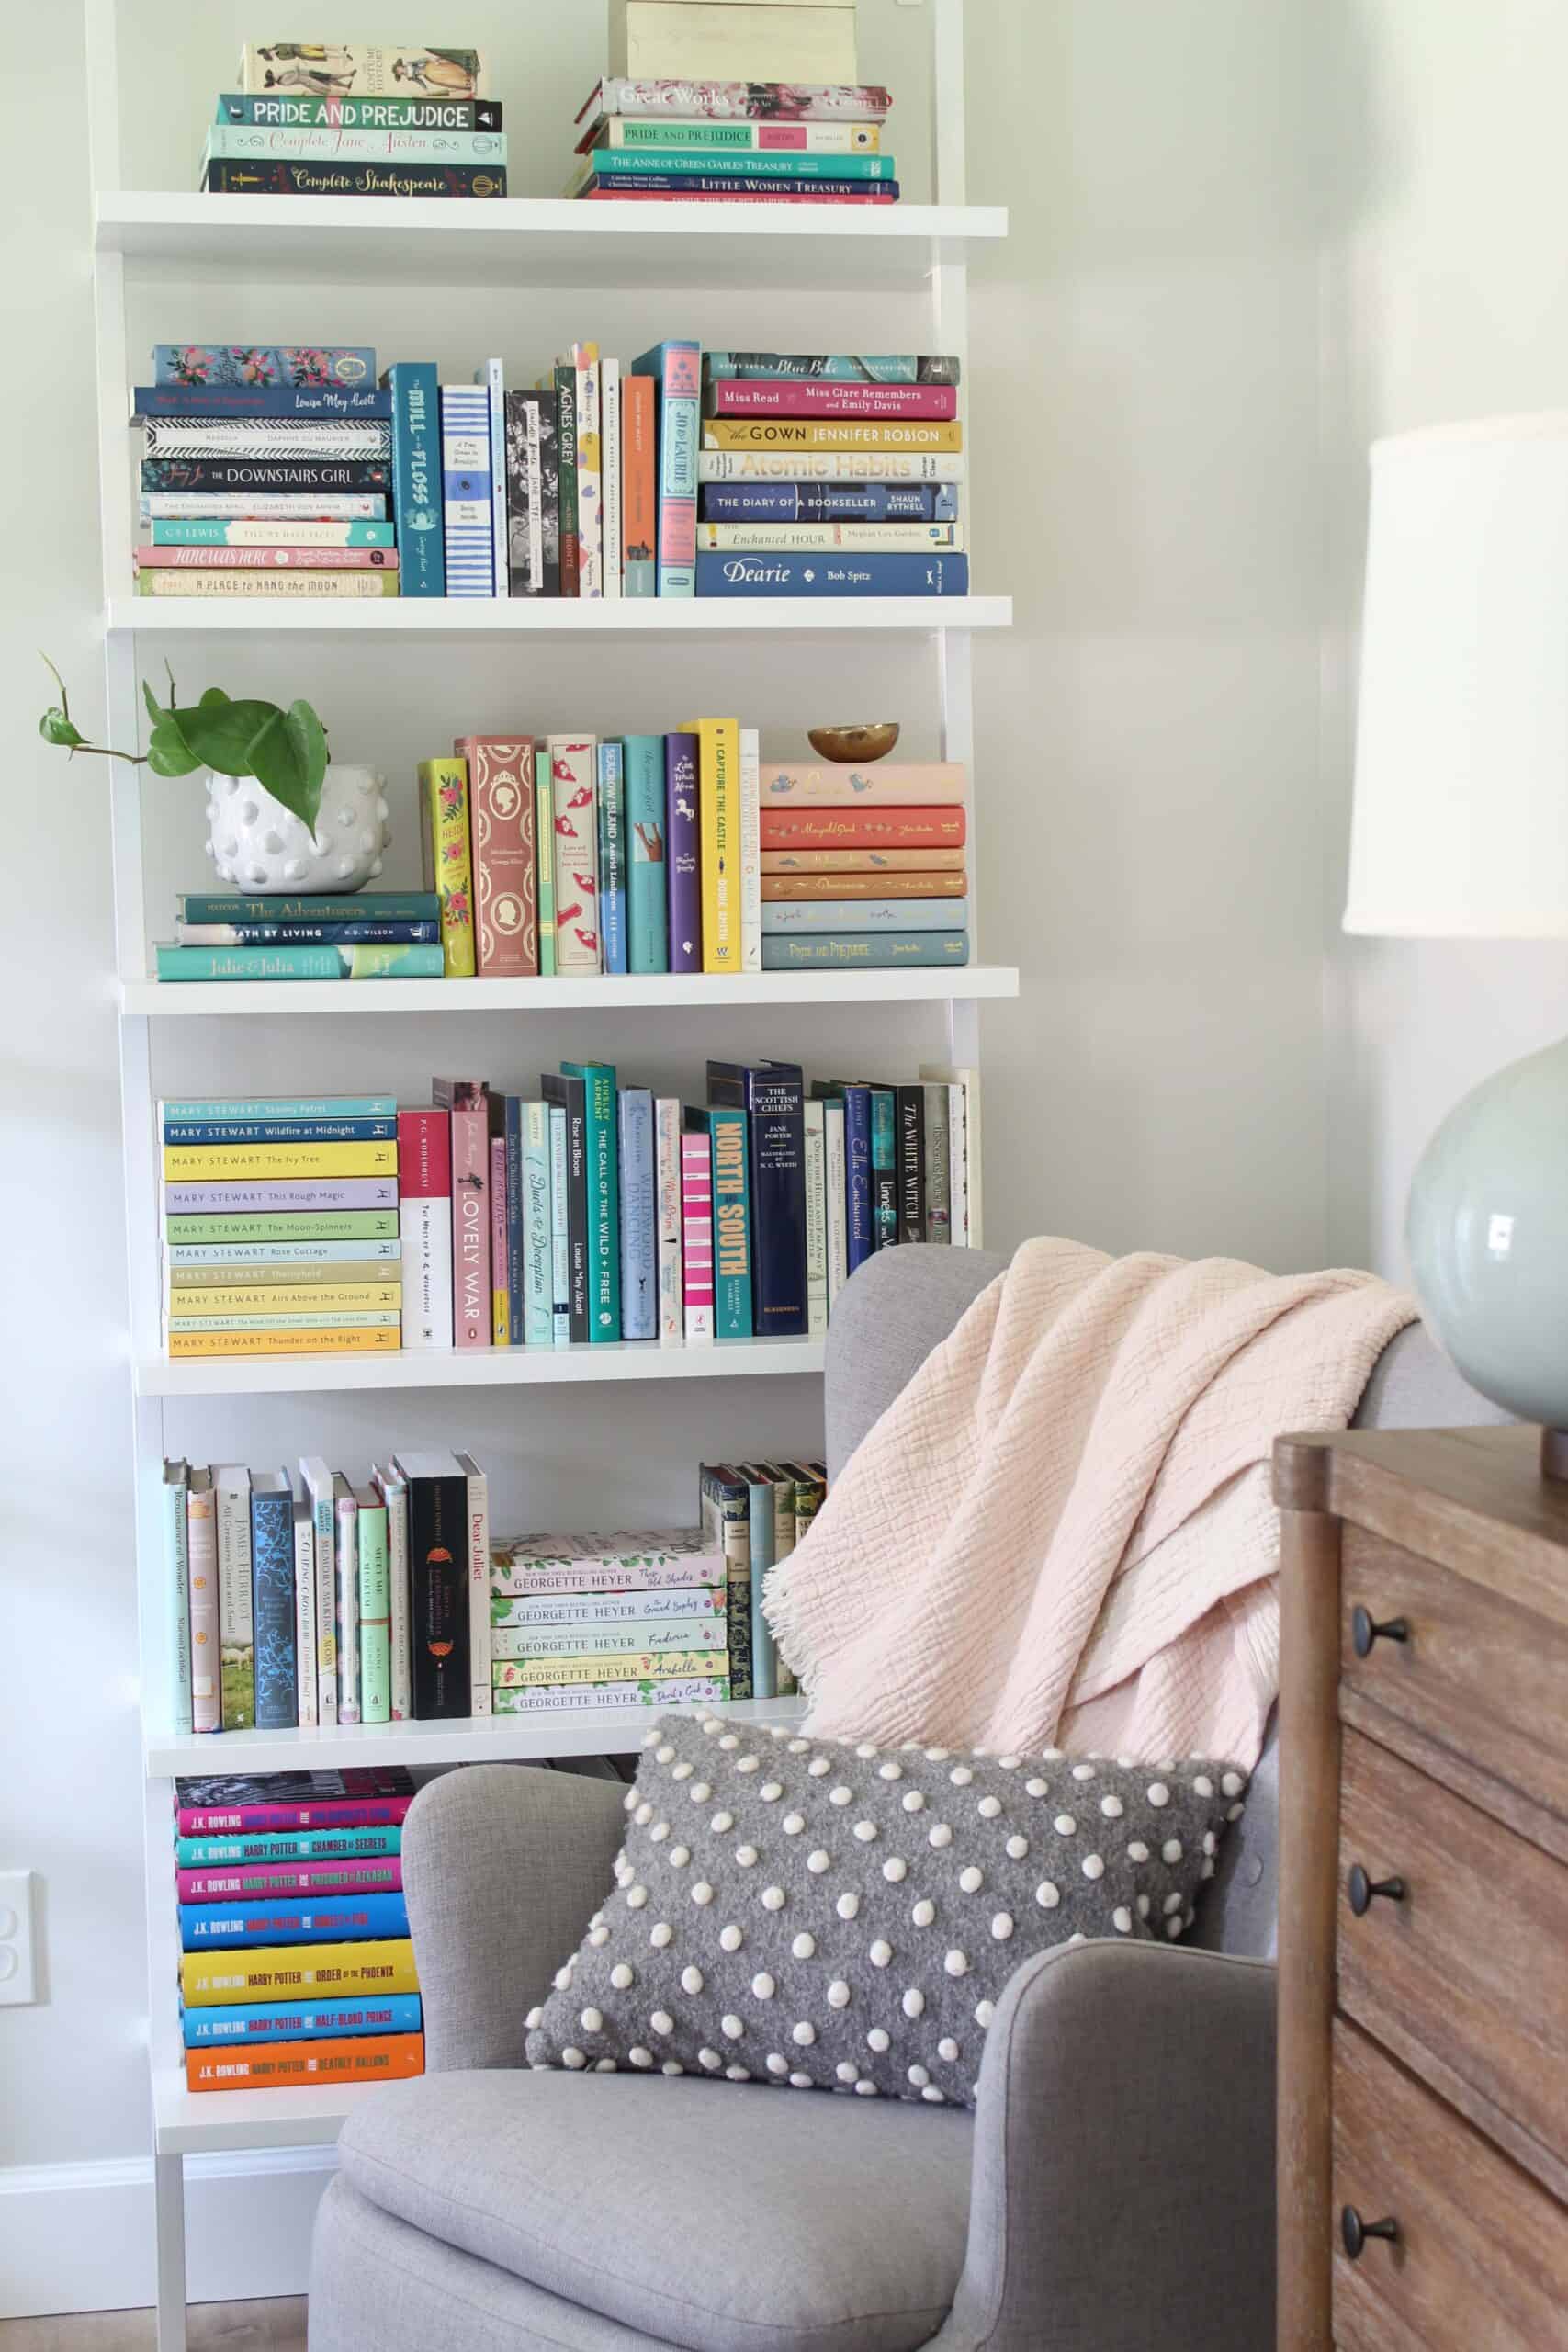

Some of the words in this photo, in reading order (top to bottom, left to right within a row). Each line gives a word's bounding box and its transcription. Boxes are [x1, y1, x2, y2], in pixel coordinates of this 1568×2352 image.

[254, 103, 310, 124] PRIDE
[316, 104, 356, 125] AND
[362, 104, 469, 127] PREJUDICE
[333, 130, 365, 152] Jane
[386, 132, 426, 153] Austen
[625, 130, 659, 140] PRIDE
[661, 131, 683, 140] AND
[688, 130, 750, 141] PREJUDICE
[611, 157, 629, 168] THE
[633, 158, 660, 167] ANNE
[660, 160, 672, 168] OF
[675, 159, 705, 169] GREEN
[707, 160, 743, 170] GABLES
[746, 161, 792, 171] TREASURY
[291, 166, 351, 191] Complete
[355, 170, 447, 195] Shakespeare
[702, 178, 740, 191] LITTLE
[745, 180, 791, 191] WOMEN
[795, 182, 852, 194] TREASURY
[560, 386, 572, 428] AGNES
[724, 392, 751, 402] Miss
[753, 393, 779, 403] Read
[806, 388, 829, 397] Miss
[832, 388, 860, 399] Clare
[863, 388, 922, 400] Remembers
[841, 401, 871, 412] Emily
[874, 401, 901, 411] Davis
[408, 389, 425, 435] MILL
[675, 412, 687, 430] JO
[560, 432, 573, 466] GREY
[674, 441, 688, 483] LAURIE
[227, 469, 318, 483] DOWNSTAIRS
[321, 469, 352, 483] GIRL
[411, 450, 428, 504] FLOSS
[740, 454, 828, 476] Atomic
[836, 455, 911, 476] Habits
[718, 498, 739, 507] THE
[743, 498, 775, 507] DIARY
[779, 498, 794, 507] OF
[797, 498, 804, 507] A
[808, 498, 876, 507] BOOKSELLER
[890, 494, 920, 503] SHAUN
[733, 533, 787, 545] Enchanted
[791, 535, 826, 544] HOUR
[723, 558, 790, 582] Dearie
[828, 571, 845, 581] Bob
[847, 571, 871, 581] Spitz
[197, 580, 203, 590] A
[206, 581, 239, 591] PLACE
[243, 580, 252, 591] to
[256, 581, 284, 590] HANG
[288, 580, 305, 591] the
[606, 748, 616, 800] SEACROW
[716, 749, 725, 790] CAPTURE
[716, 795, 725, 812] THE
[607, 801, 617, 839] ISLAND
[716, 816, 726, 850] CASTLE
[609, 842, 617, 869] Astrid
[608, 872, 618, 911] Lindgren
[719, 910, 728, 941] SMITH
[755, 1095, 798, 1103] SCOTTISH
[903, 1102, 918, 1126] The
[170, 1127, 201, 1137] MARY
[207, 1127, 259, 1136] STEWART
[265, 1125, 300, 1136] Wildfire
[316, 1125, 355, 1136] Midnight
[598, 1130, 606, 1148] THE
[172, 1157, 202, 1166] MARY
[209, 1156, 261, 1165] STEWART
[267, 1156, 283, 1164] The
[286, 1156, 299, 1165] Ivy
[716, 1122, 744, 1194] NORTH
[852, 1138, 867, 1170] Ella
[905, 1129, 918, 1173] WHITE
[599, 1152, 607, 1178] CALL
[529, 1174, 545, 1214] Duels
[600, 1182, 607, 1195] OF
[880, 1182, 894, 1222] Linnets
[905, 1177, 919, 1219] WITCH
[600, 1198, 608, 1219] THE
[852, 1174, 868, 1240] Enchanted
[174, 1225, 204, 1234] MARY
[210, 1224, 262, 1233] STEWART
[268, 1224, 284, 1232] The
[287, 1222, 352, 1232] Moon-Spinners
[463, 1192, 479, 1265] LOVELY
[626, 1183, 640, 1260] DANCING
[600, 1222, 609, 1256] WILD
[718, 1204, 748, 1276] SOUTH
[528, 1233, 548, 1295] Deception
[177, 1295, 208, 1305] MARY
[214, 1295, 265, 1304] STEWART
[272, 1294, 288, 1302] Airs
[290, 1294, 319, 1302] Above
[321, 1293, 335, 1301] the
[338, 1292, 370, 1301] Ground
[463, 1271, 479, 1319] WAR
[600, 1271, 610, 1304] FREE
[173, 1339, 204, 1348] MARY
[210, 1338, 262, 1347] STEWART
[268, 1337, 303, 1345] Thunder
[321, 1336, 335, 1344] the
[338, 1335, 361, 1345] Right
[175, 1491, 184, 1544] Renaissance
[471, 1513, 483, 1544] Dear
[223, 1520, 233, 1562] Creatures
[236, 1518, 248, 1557] JAMES
[321, 1540, 331, 1587] MEMORY
[375, 1547, 383, 1576] MEET
[472, 1545, 483, 1580] Juliet
[175, 1560, 185, 1595] Wonder
[225, 1565, 234, 1589] Great
[377, 1580, 383, 1596] ME
[226, 1591, 234, 1607] and
[237, 1563, 252, 1622] HERRIOT
[226, 1610, 235, 1634] Small
[321, 1591, 332, 1635] MAKING
[322, 1639, 333, 1667] MOM
[520, 1670, 591, 1683] GEORGETTE
[597, 1668, 637, 1679] HEYER
[653, 1659, 698, 1675] Arabella
[191, 1817, 206, 1830] J.K.
[208, 1815, 242, 1829] ROWLING
[192, 1849, 206, 1860] J.K.
[208, 1846, 242, 1859] ROWLING
[244, 1844, 267, 1857] HARRY
[270, 1842, 298, 1855] POTTER
[312, 1838, 347, 1852] CHAMBER
[355, 1838, 387, 1850] SECRETS
